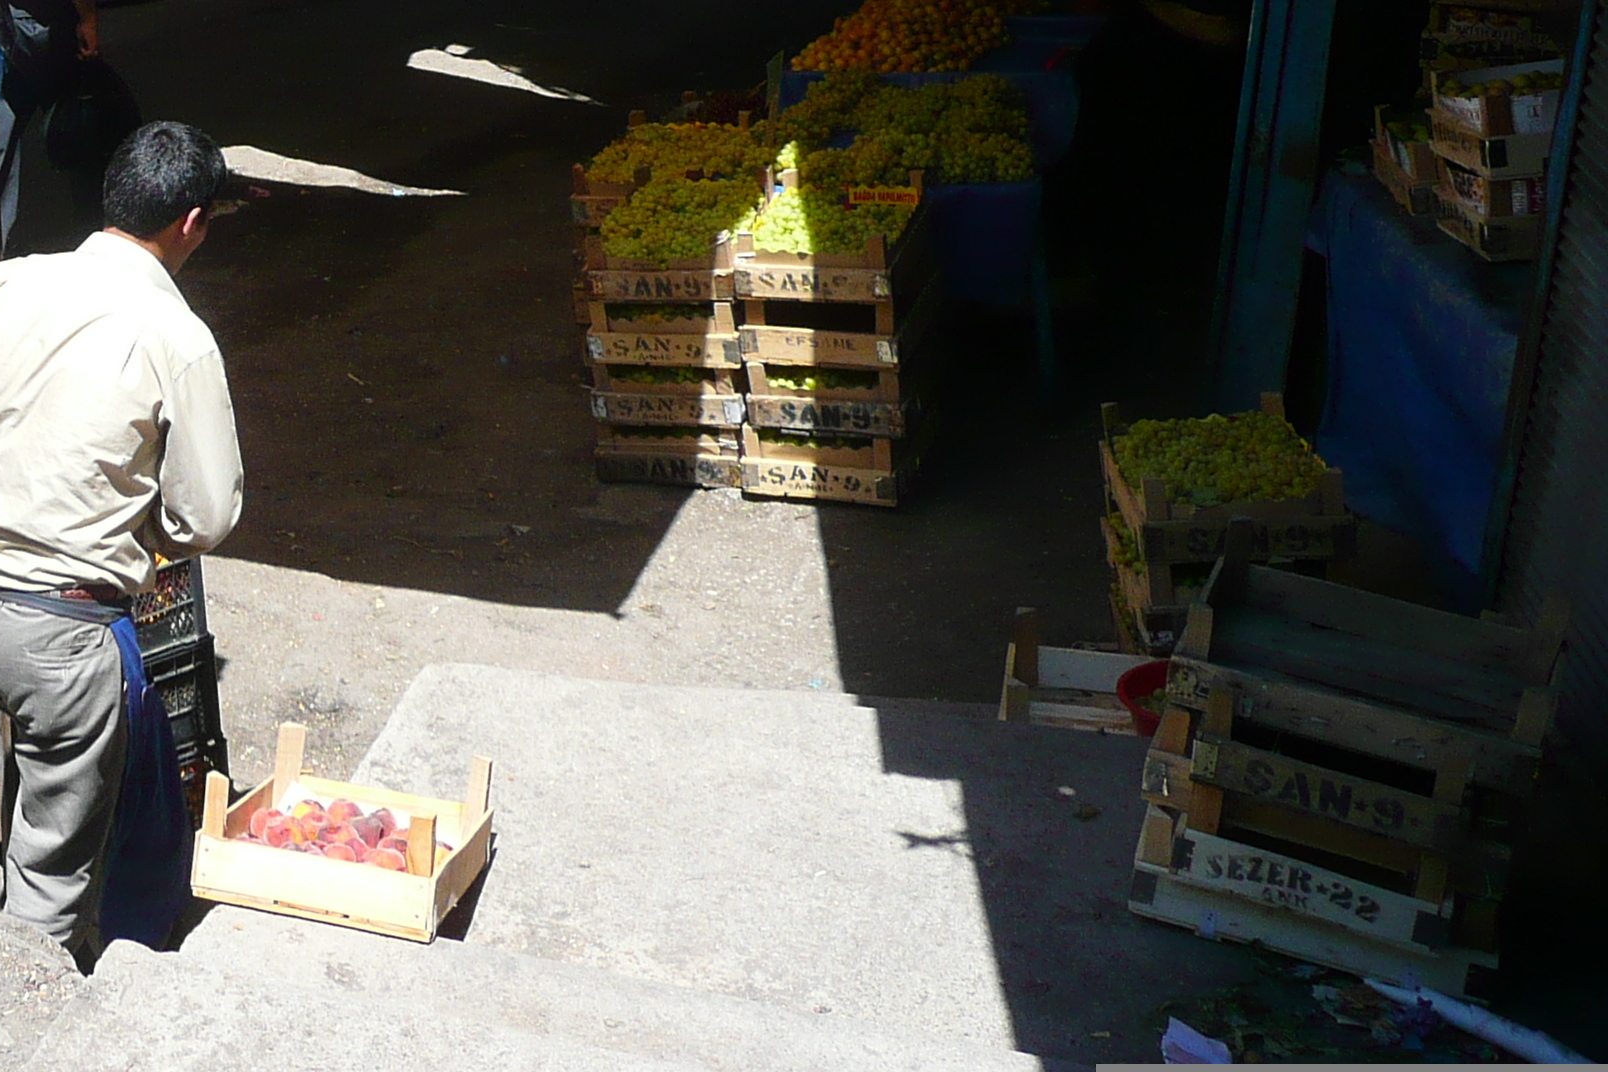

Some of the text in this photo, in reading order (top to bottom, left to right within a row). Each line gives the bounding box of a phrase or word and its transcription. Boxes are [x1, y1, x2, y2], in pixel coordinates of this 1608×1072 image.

[611, 335, 671, 357] SAN
[780, 402, 842, 428] SAN
[767, 465, 830, 485] SAN
[1243, 759, 1353, 820] SAN
[1206, 853, 1312, 894] SEZER
